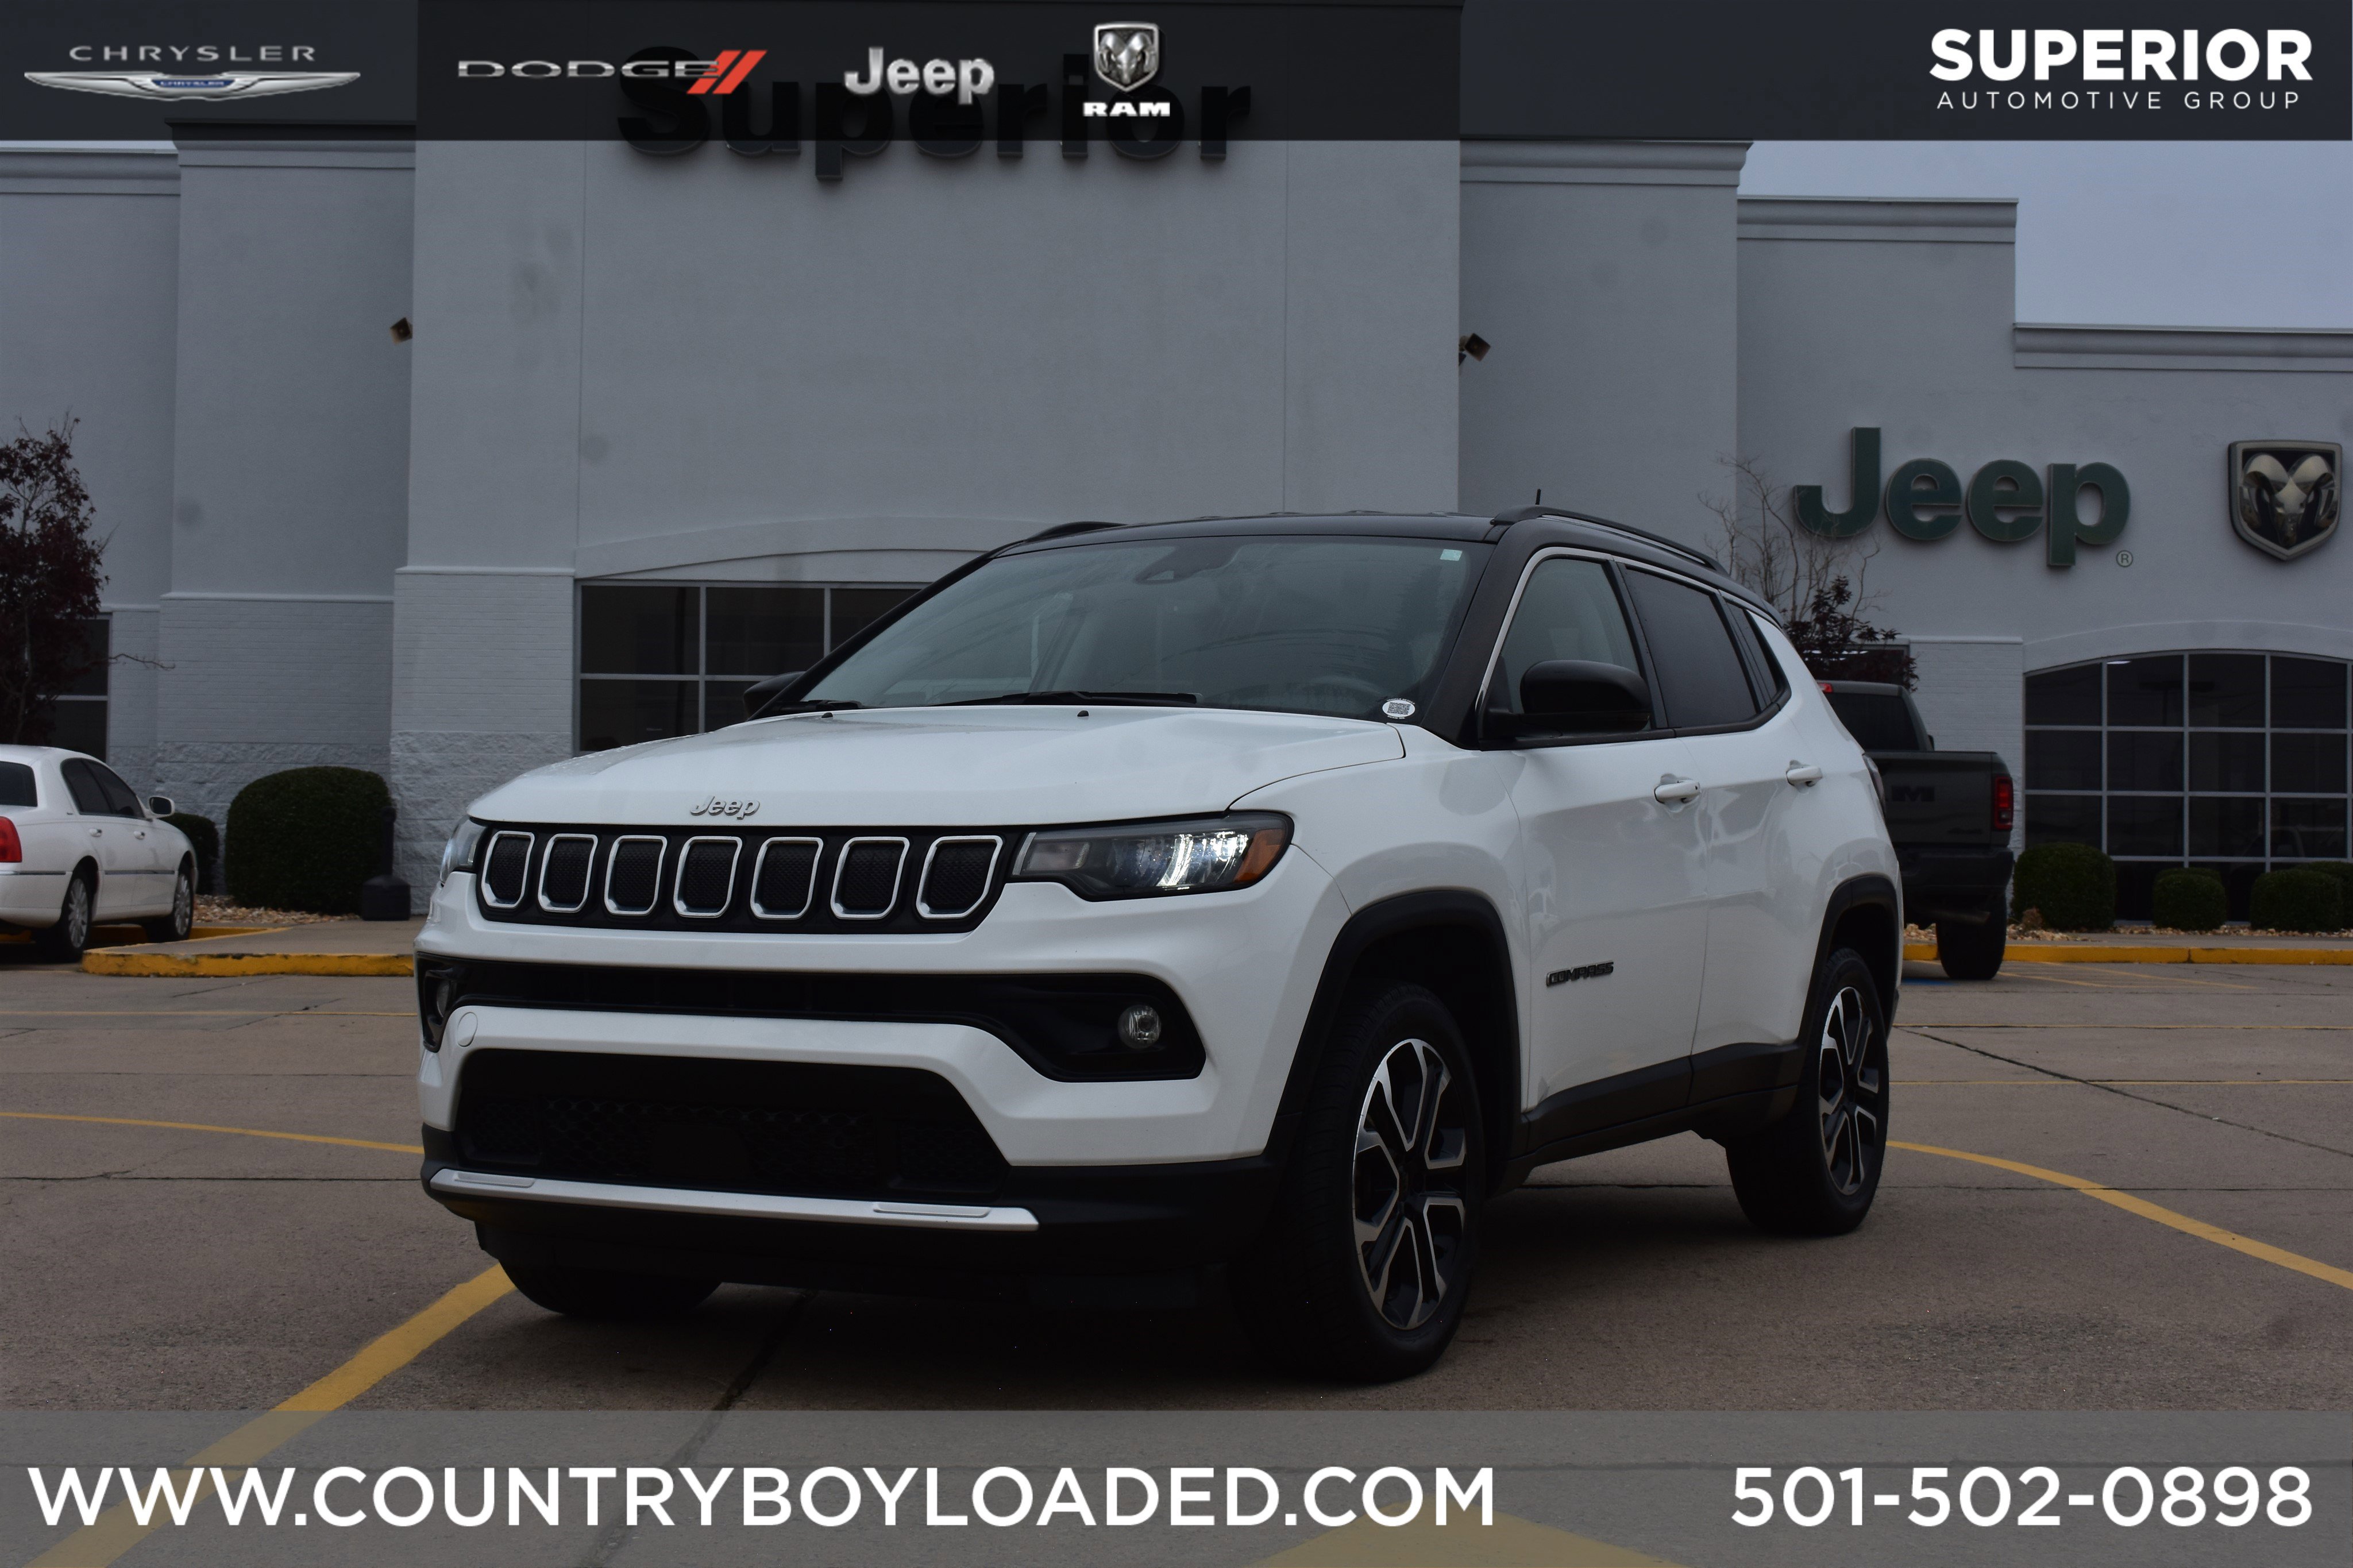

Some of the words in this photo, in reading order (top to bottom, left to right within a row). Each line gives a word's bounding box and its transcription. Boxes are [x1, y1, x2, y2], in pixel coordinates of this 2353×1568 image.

[1792, 426, 2131, 568] Jeep
[690, 795, 761, 820] Jeep
[1546, 960, 1614, 987] COMPASS
